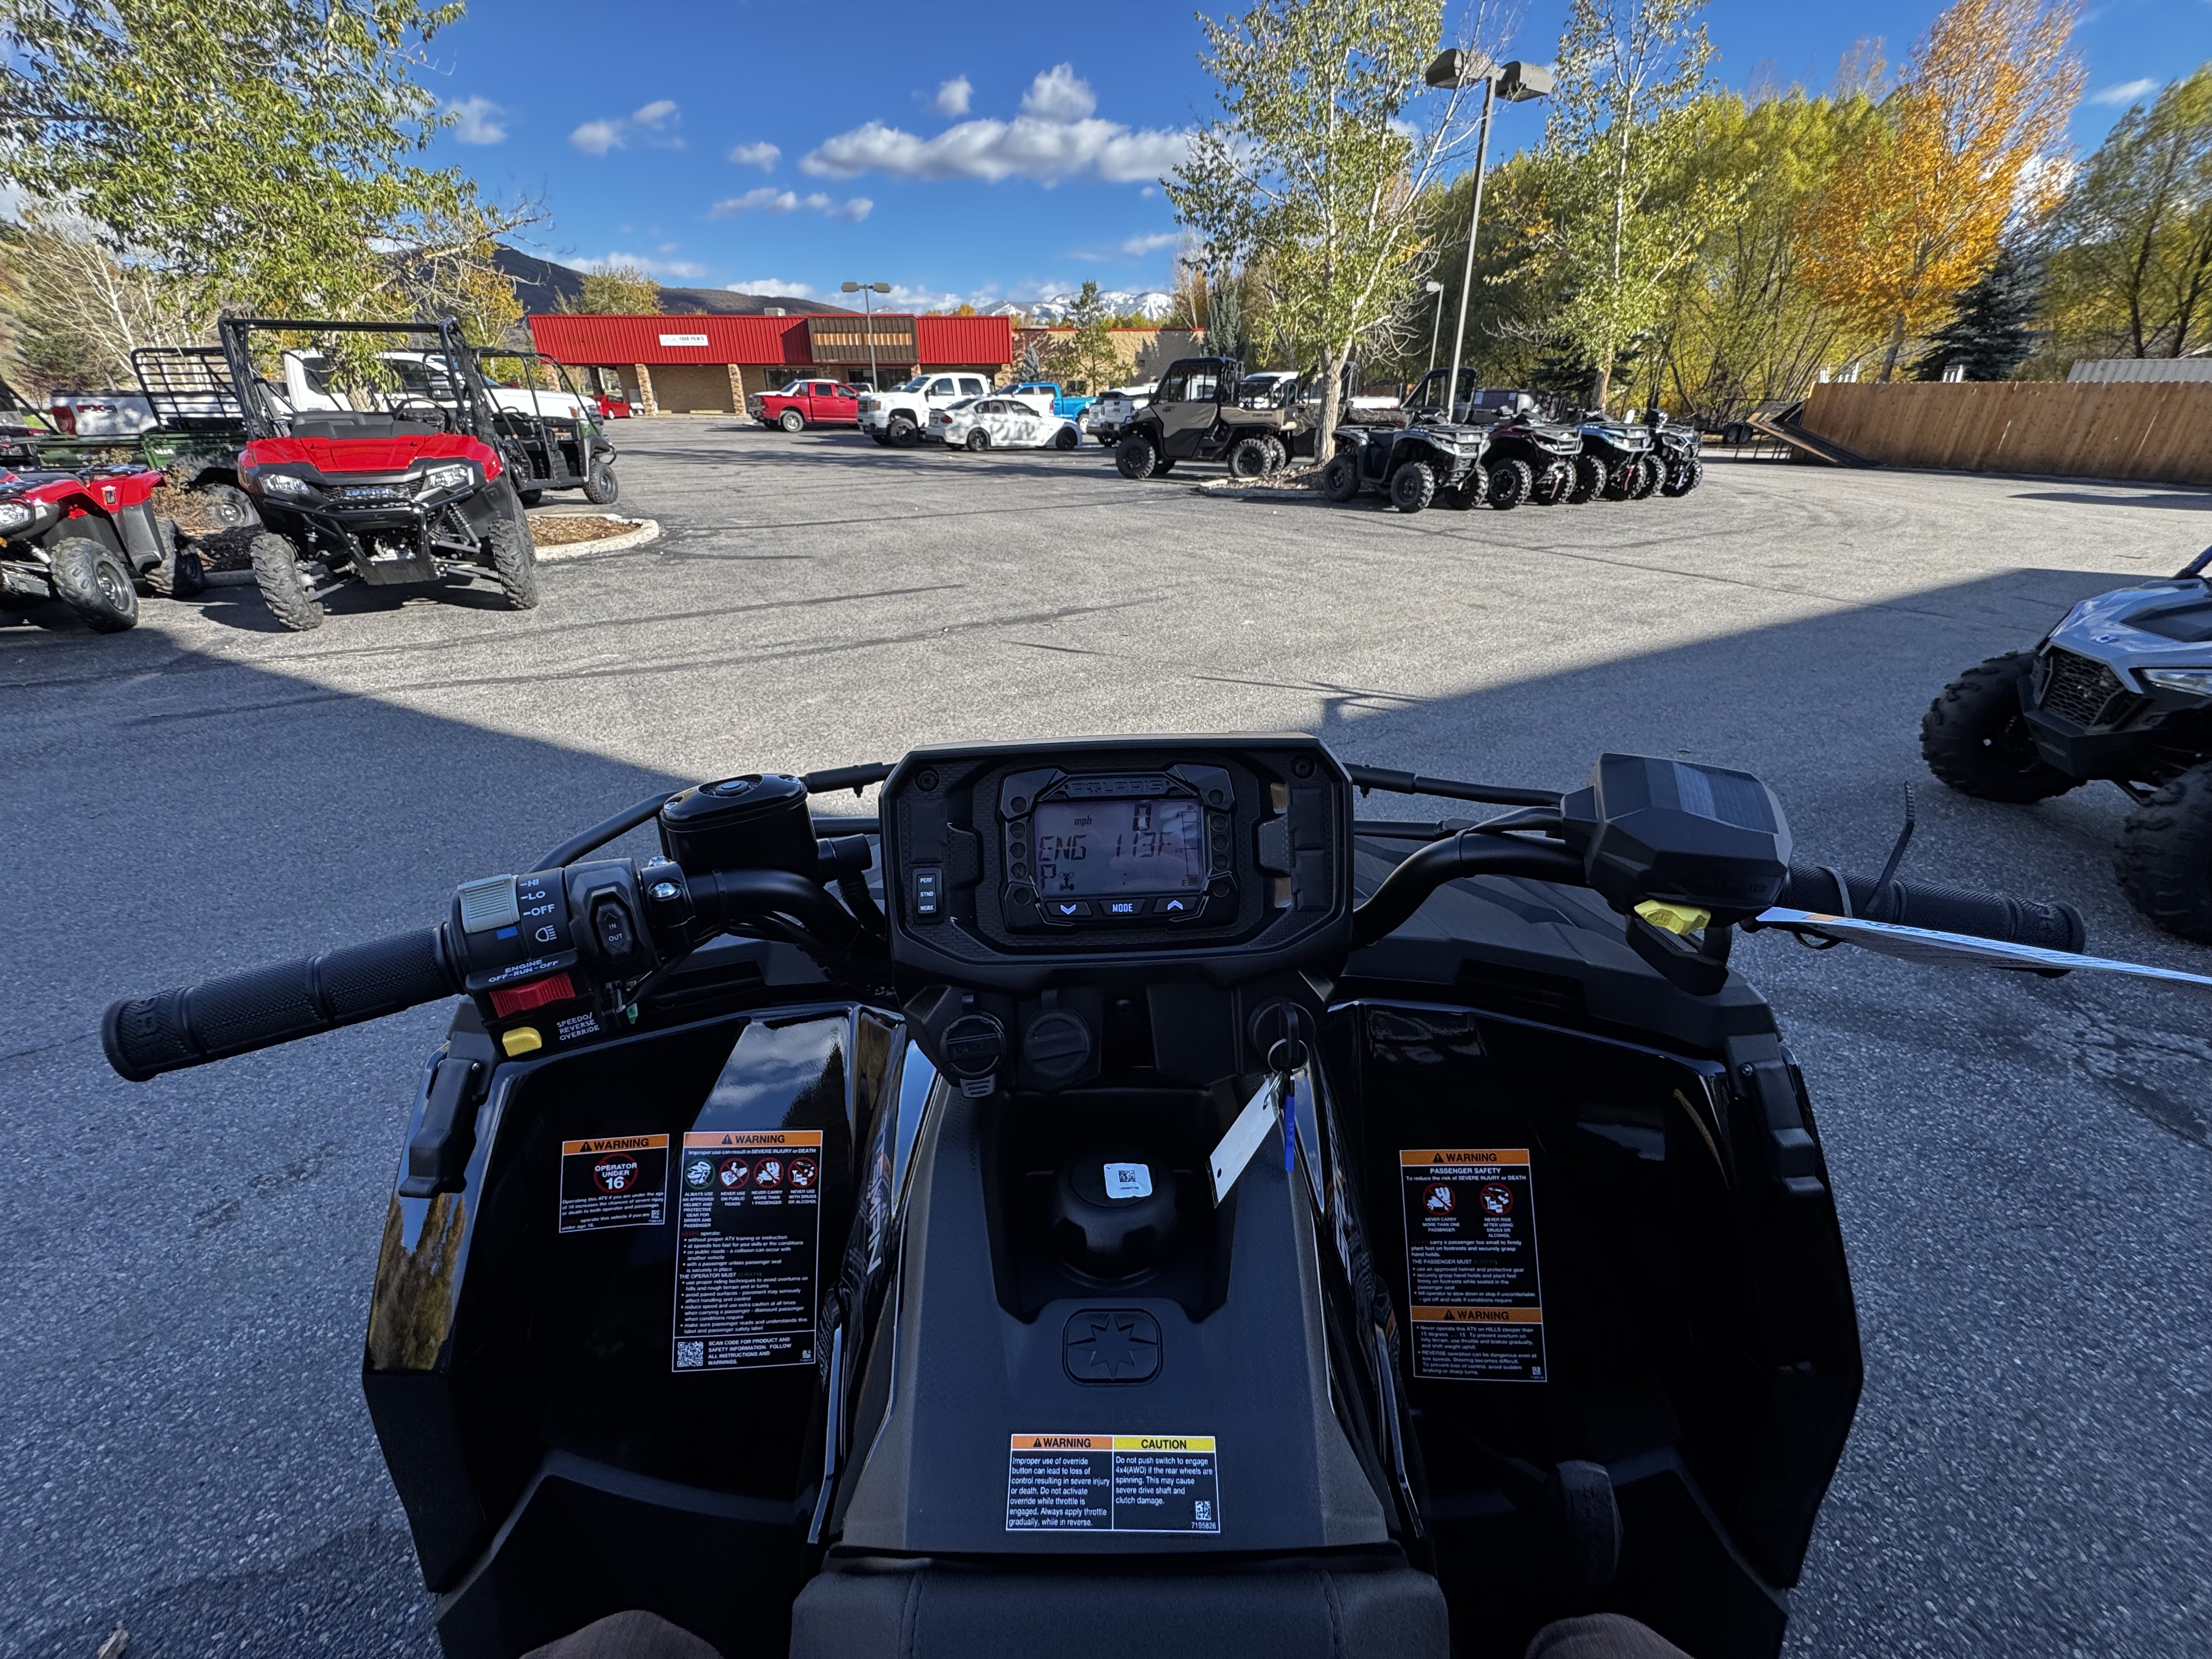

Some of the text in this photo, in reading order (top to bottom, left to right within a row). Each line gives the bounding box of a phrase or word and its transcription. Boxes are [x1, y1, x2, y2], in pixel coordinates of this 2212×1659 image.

[1070, 780, 1163, 794] POLARIS
[1074, 815, 1092, 827] mph
[1039, 831, 1173, 861] ENG 113F
[1041, 864, 1057, 889] P
[1112, 903, 1133, 913] MODE
[608, 933, 623, 942] OUT
[505, 959, 543, 974] ENGINE
[556, 1012, 593, 1028] SPEEDO/
[559, 1019, 596, 1035] REVERSE
[559, 1024, 600, 1041] OVERRIDE
[594, 1138, 649, 1150] WARNING
[735, 1135, 785, 1143] WARNING
[1446, 1153, 1497, 1161] WARNING
[595, 1163, 637, 1171] OPERATOR
[605, 1176, 624, 1189] 16
[1457, 1310, 1509, 1319] WARNING
[1044, 1438, 1091, 1448] WARNING
[1141, 1439, 1187, 1449] CAUTION
[1138, 1457, 1153, 1465] push
[1116, 1466, 1146, 1474] 4x4(AWD)
[1035, 1477, 1062, 1485] resulting
[1093, 1477, 1110, 1486] injury
[1116, 1476, 1144, 1485] spinning.
[1009, 1508, 1039, 1516] engaged.
[1040, 1507, 1063, 1516] Always
[1064, 1508, 1082, 1516] apply
[1009, 1517, 1040, 1526] gradually,
